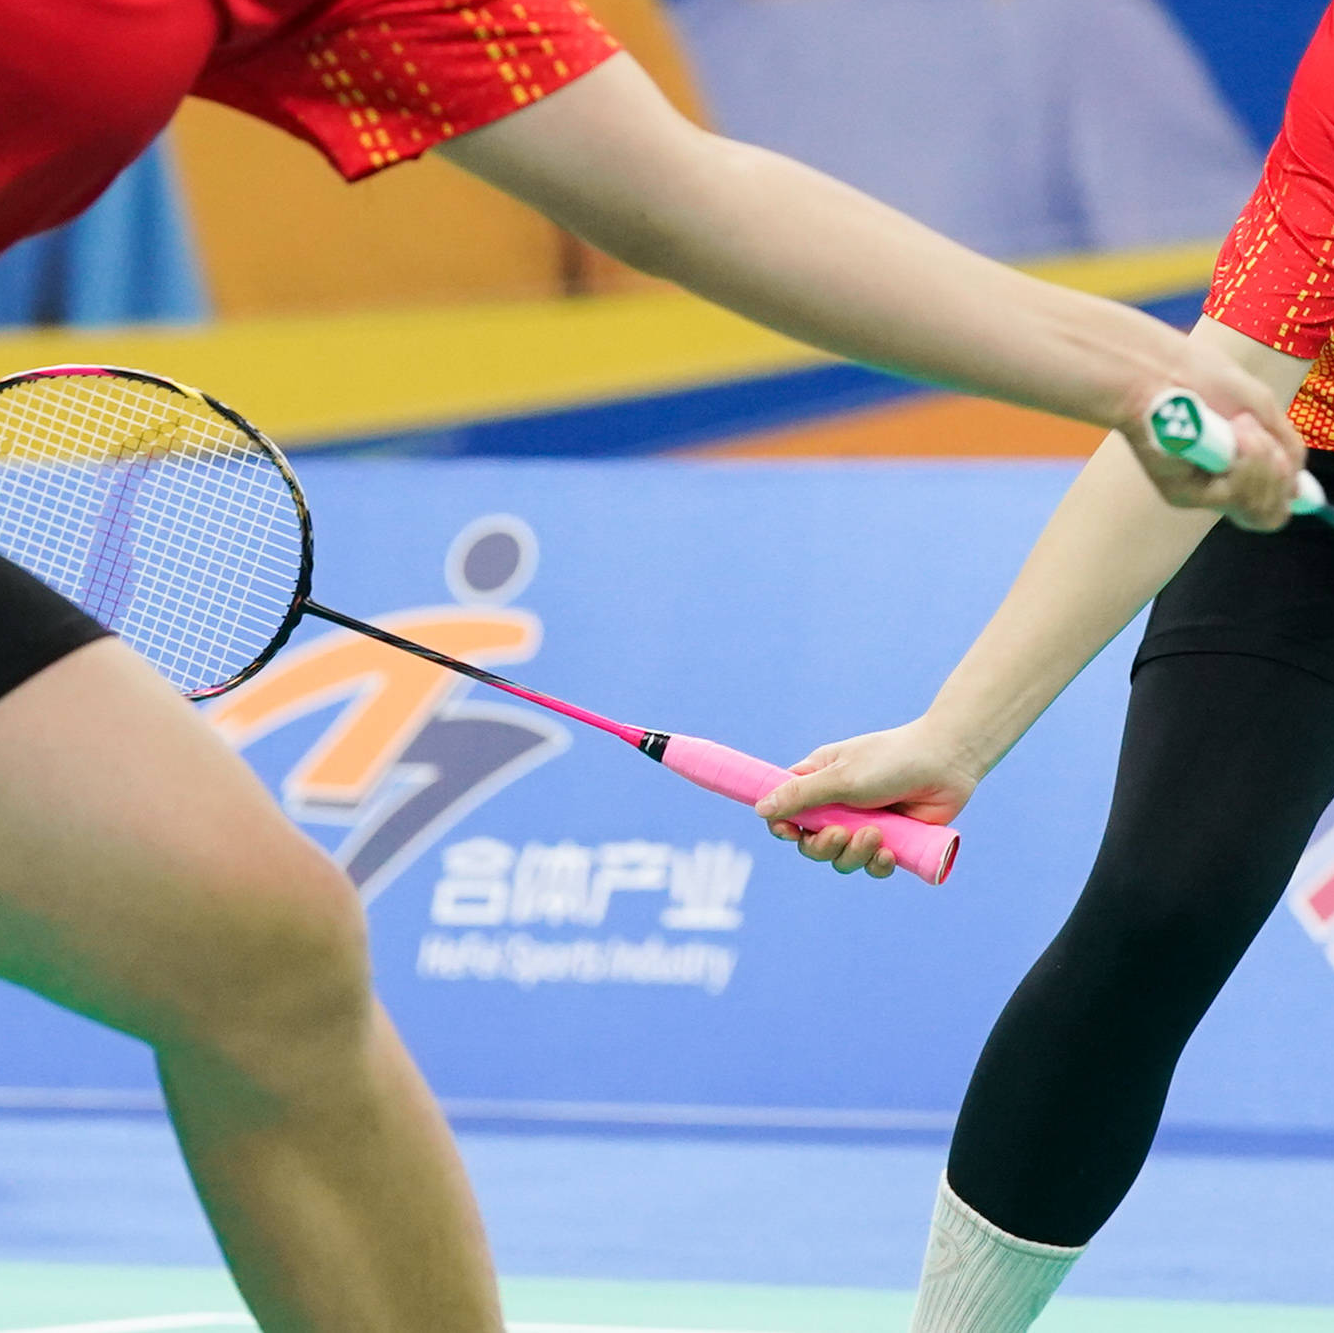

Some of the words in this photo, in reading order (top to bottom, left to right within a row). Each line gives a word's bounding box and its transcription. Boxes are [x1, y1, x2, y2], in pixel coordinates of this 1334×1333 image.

[432, 837, 753, 930] 合体产业
[508, 932, 605, 990] Sports
[610, 934, 739, 996] Industry
